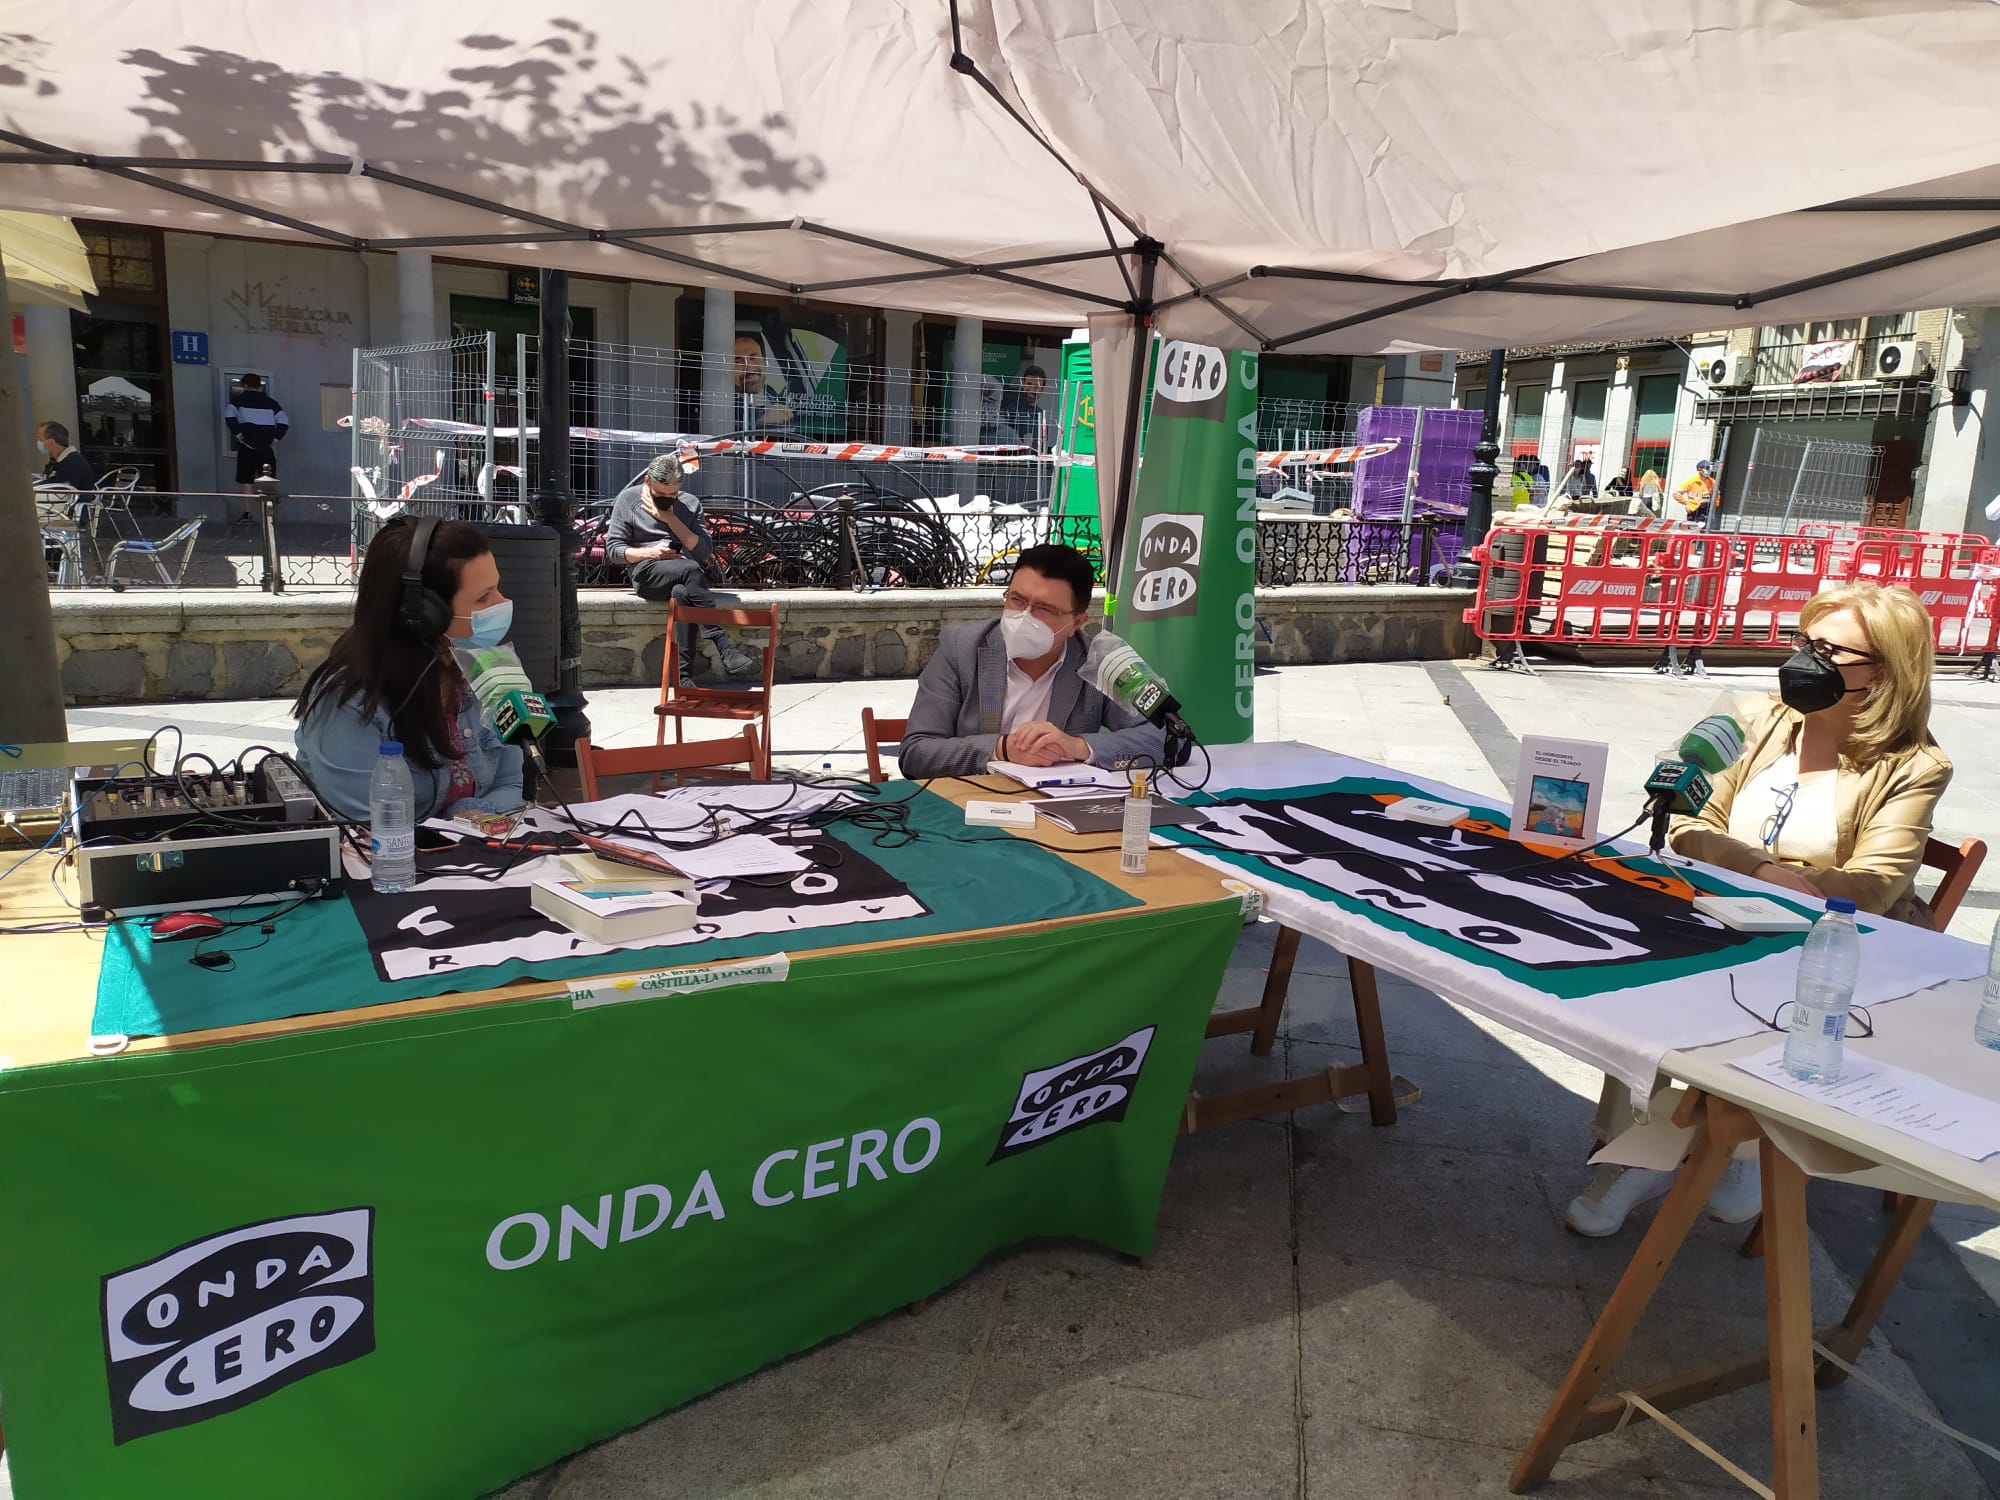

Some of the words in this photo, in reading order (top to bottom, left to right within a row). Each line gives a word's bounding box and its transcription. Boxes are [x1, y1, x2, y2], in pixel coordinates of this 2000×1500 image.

[182, 335, 199, 352] H
[1164, 348, 1222, 391] CERO
[1236, 409, 1258, 564] ONDA
[1144, 535, 1191, 558] ONDA
[1140, 576, 1188, 603] CERO
[1235, 592, 1256, 719] CERO
[1033, 1054, 1124, 1105] ONDA
[486, 1169, 725, 1271] ONDA
[751, 1117, 942, 1207] CERO
[146, 1244, 332, 1329] ONDA
[164, 1305, 336, 1396] CERO
